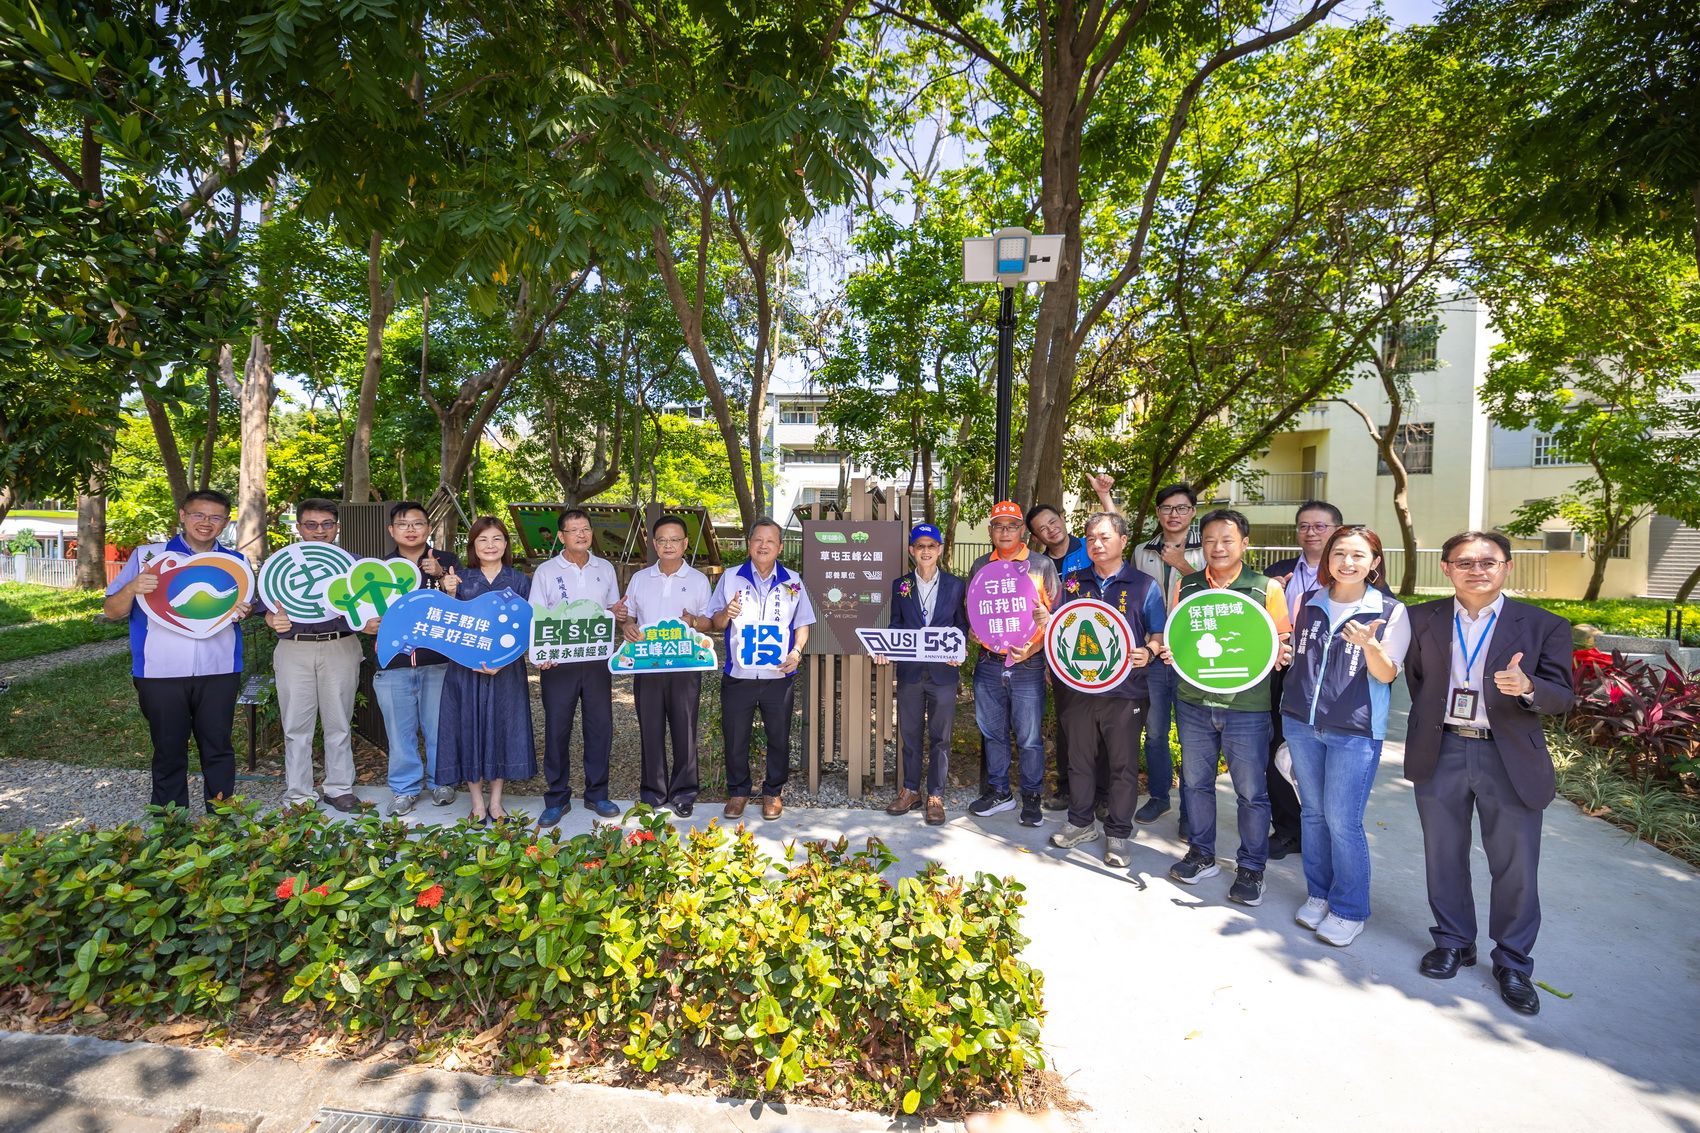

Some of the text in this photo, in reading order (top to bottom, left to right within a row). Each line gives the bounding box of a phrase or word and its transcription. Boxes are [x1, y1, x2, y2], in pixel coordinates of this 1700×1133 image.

[820, 551, 883, 562] 草屯玉峰公園
[825, 571, 855, 580] 認養單位
[984, 577, 1018, 595] 守護
[978, 597, 1027, 615] 你我的
[1119, 590, 1128, 616] 草屯鎮
[1188, 602, 1245, 619] 保育陸域
[426, 606, 491, 632] 攜手夥伴
[988, 617, 1021, 634] 健康
[1190, 618, 1218, 632] 生態
[412, 621, 494, 651] 共享好空氣
[646, 628, 683, 641] 草屯鎮
[890, 631, 962, 653] USI 50
[535, 645, 608, 661] 企業永續經營
[634, 640, 693, 657] 玉峰公園
[741, 624, 783, 666] 投
